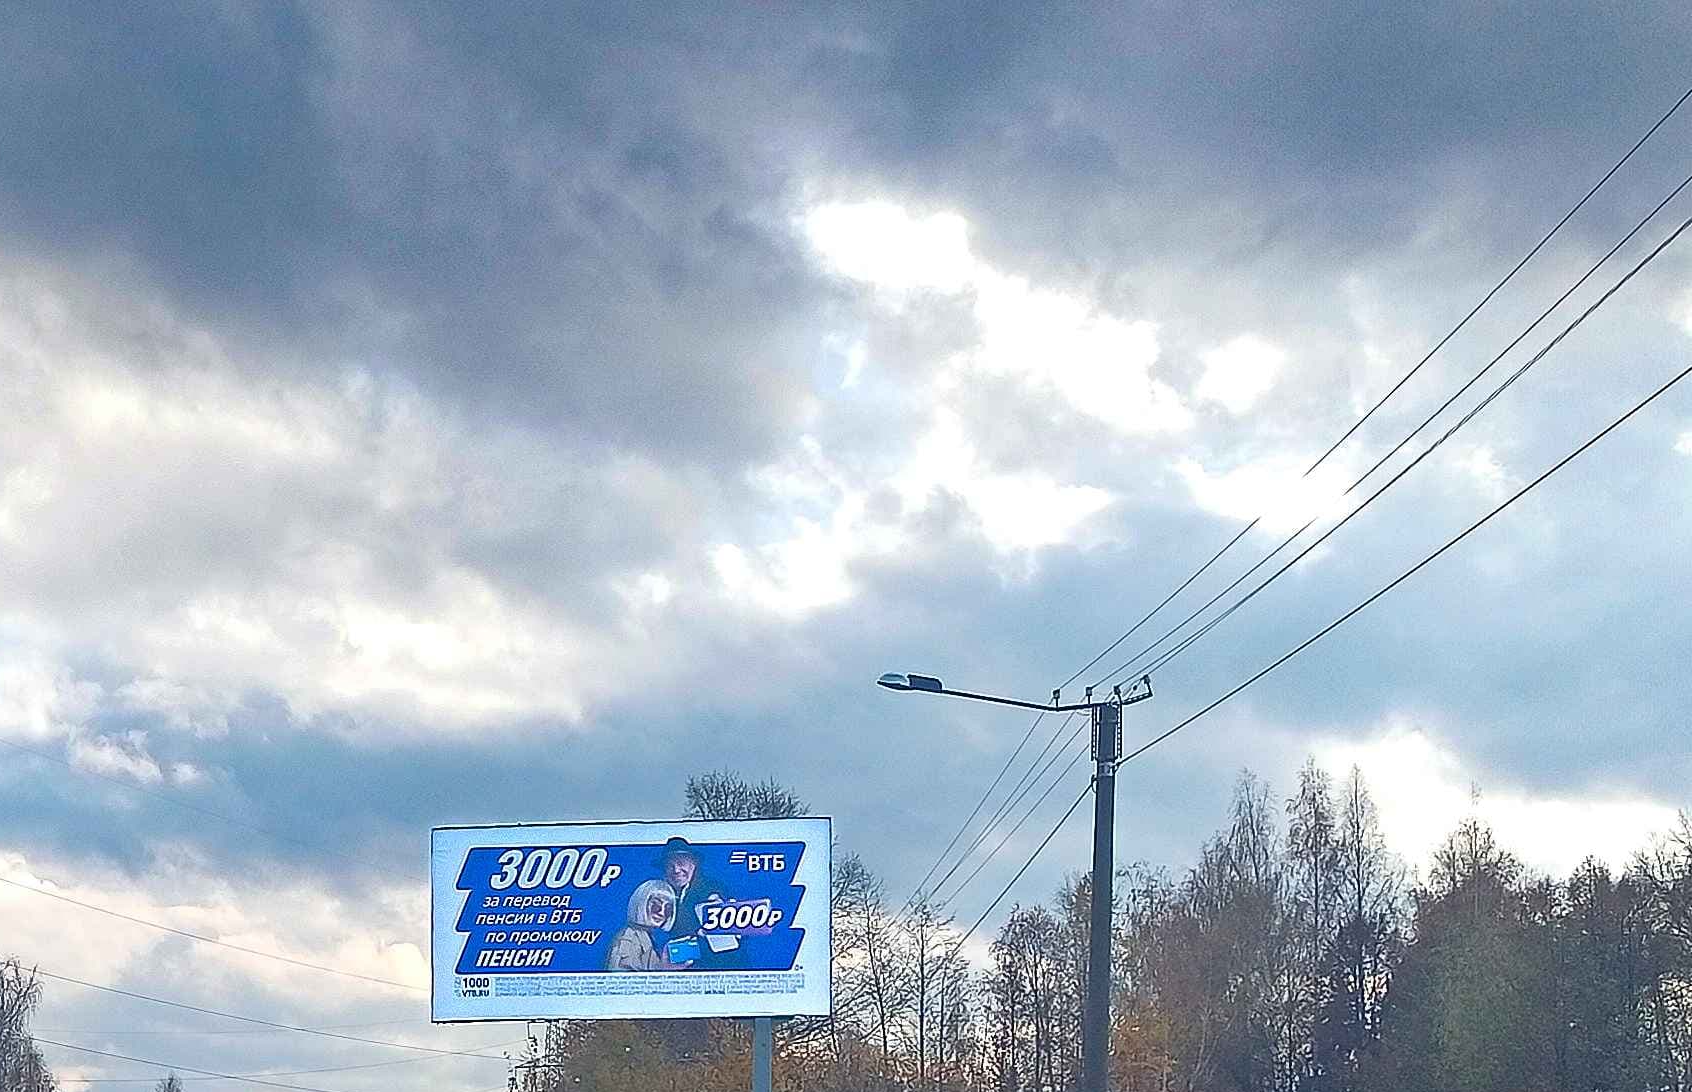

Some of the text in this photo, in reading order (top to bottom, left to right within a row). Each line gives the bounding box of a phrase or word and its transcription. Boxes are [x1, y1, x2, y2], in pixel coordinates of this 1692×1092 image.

[748, 855, 785, 871] ВТБ
[482, 895, 571, 909] за перевод
[475, 909, 583, 925] пенсии в ВТБ
[485, 930, 602, 945] по промокоду
[476, 949, 555, 967] ПЕНСИЯ
[462, 977, 490, 988] 1000
